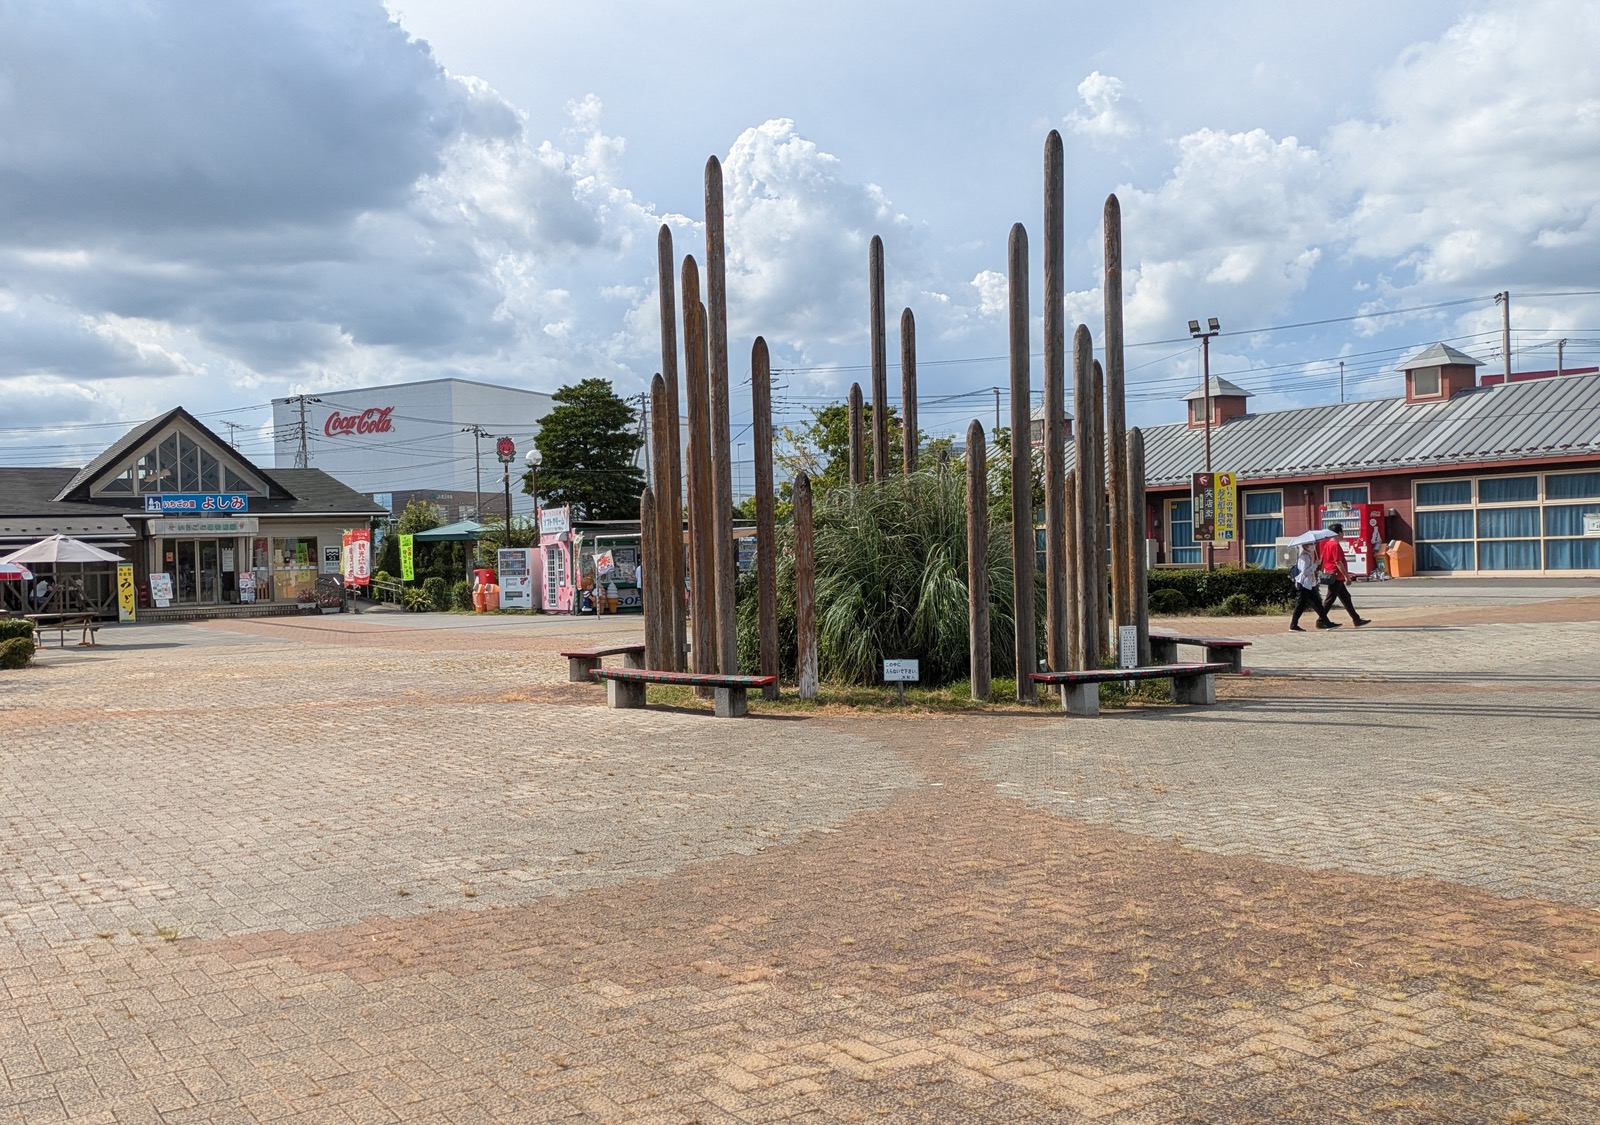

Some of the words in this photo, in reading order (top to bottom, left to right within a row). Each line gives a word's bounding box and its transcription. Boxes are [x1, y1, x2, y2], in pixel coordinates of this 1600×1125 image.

[324, 406, 395, 437] Coca-Cola
[202, 496, 245, 509] よしみ
